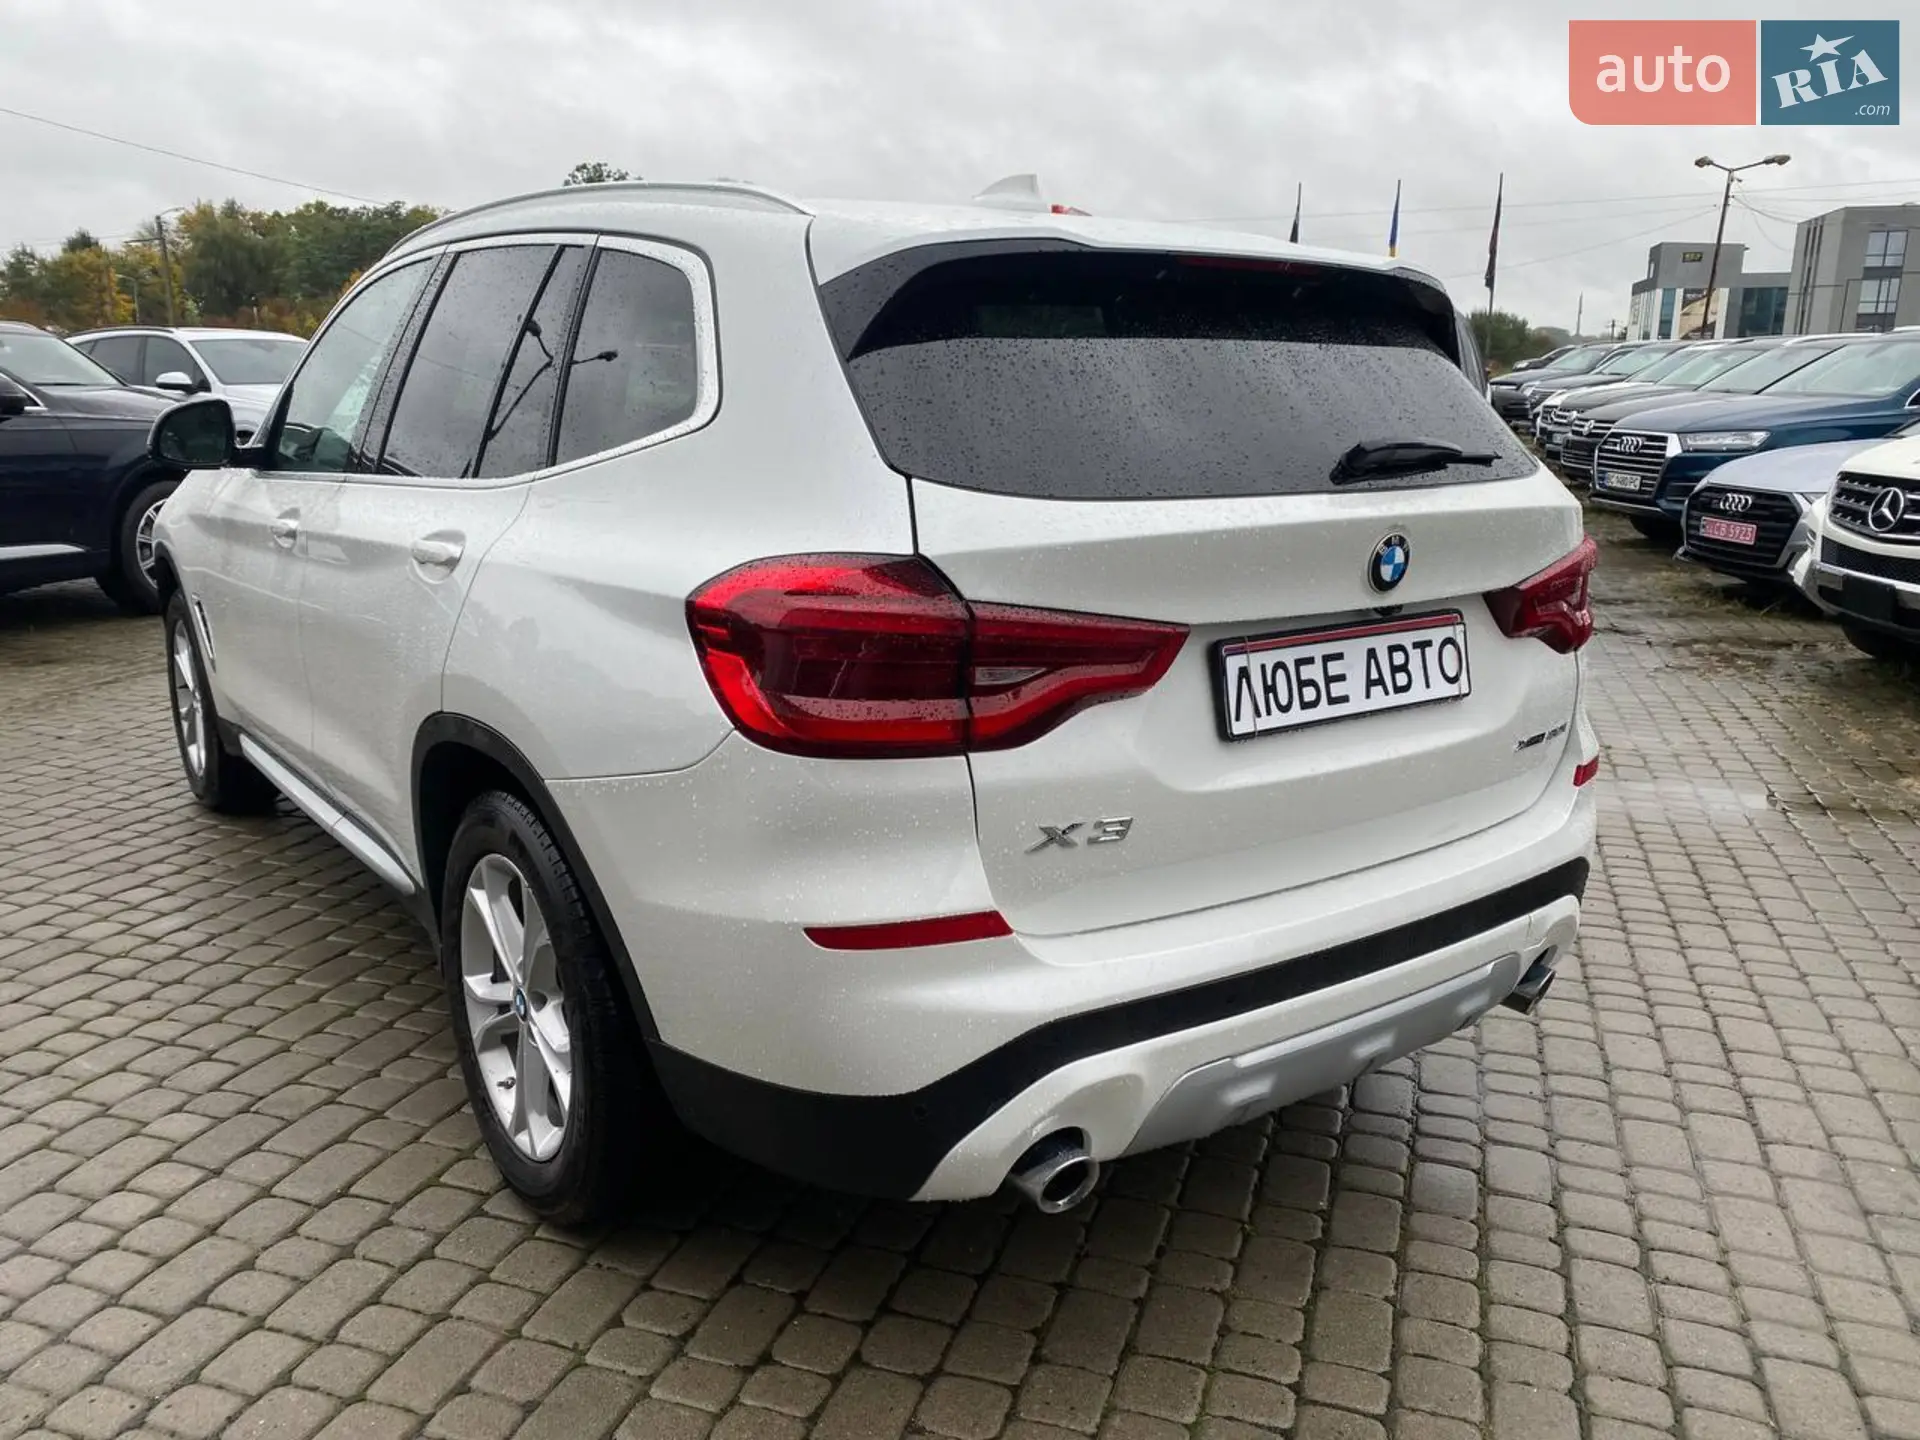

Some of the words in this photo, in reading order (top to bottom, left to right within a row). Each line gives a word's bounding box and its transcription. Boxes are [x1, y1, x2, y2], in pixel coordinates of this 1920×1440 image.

[1234, 652, 1350, 722] ЛЮБЕ
[1365, 636, 1463, 700] АВТО
[1024, 816, 1134, 854] X3
